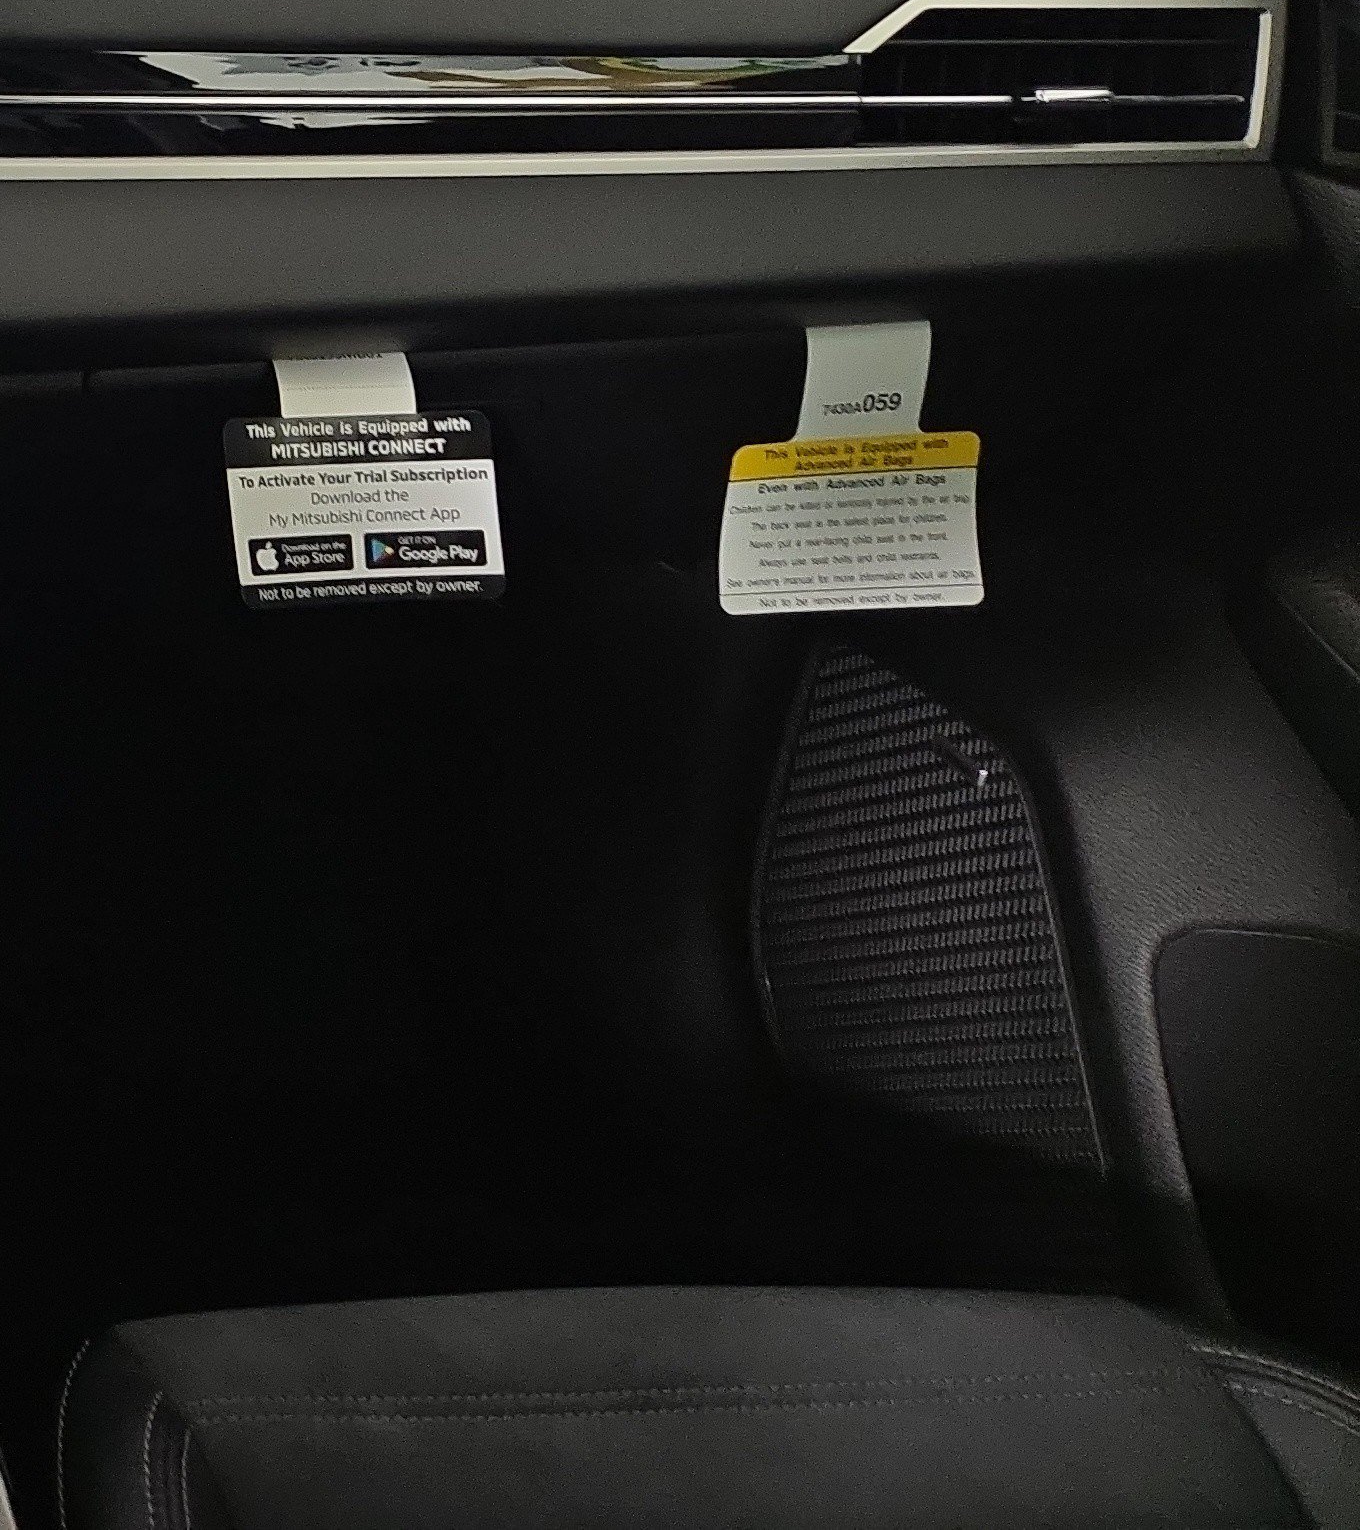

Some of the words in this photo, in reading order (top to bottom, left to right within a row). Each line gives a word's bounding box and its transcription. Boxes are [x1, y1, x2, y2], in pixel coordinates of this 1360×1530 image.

[244, 422, 277, 439] This
[280, 421, 334, 438] Vehicle
[340, 420, 353, 436] is
[357, 417, 429, 437] Equipped
[433, 416, 472, 432] with
[271, 440, 365, 459] MITSUBISHI
[367, 437, 447, 456] CONNECT
[238, 475, 255, 489] To
[257, 473, 316, 488] Activate
[317, 471, 353, 485] Your
[353, 469, 389, 484] Trial
[390, 466, 489, 485] Subscription
[310, 489, 381, 505] Download
[384, 488, 410, 502] the
[268, 512, 289, 528] My
[292, 509, 363, 526] Mitsubishi
[366, 507, 427, 523] Connect
[429, 507, 461, 523] App
[284, 553, 311, 568] App
[311, 552, 346, 565] Store
[398, 545, 449, 564] Google
[449, 544, 479, 563] Play
[258, 588, 281, 601] Not
[281, 587, 295, 600] to
[295, 585, 311, 599] be
[312, 581, 367, 598] removed
[369, 580, 415, 596] except
[415, 579, 434, 595] by
